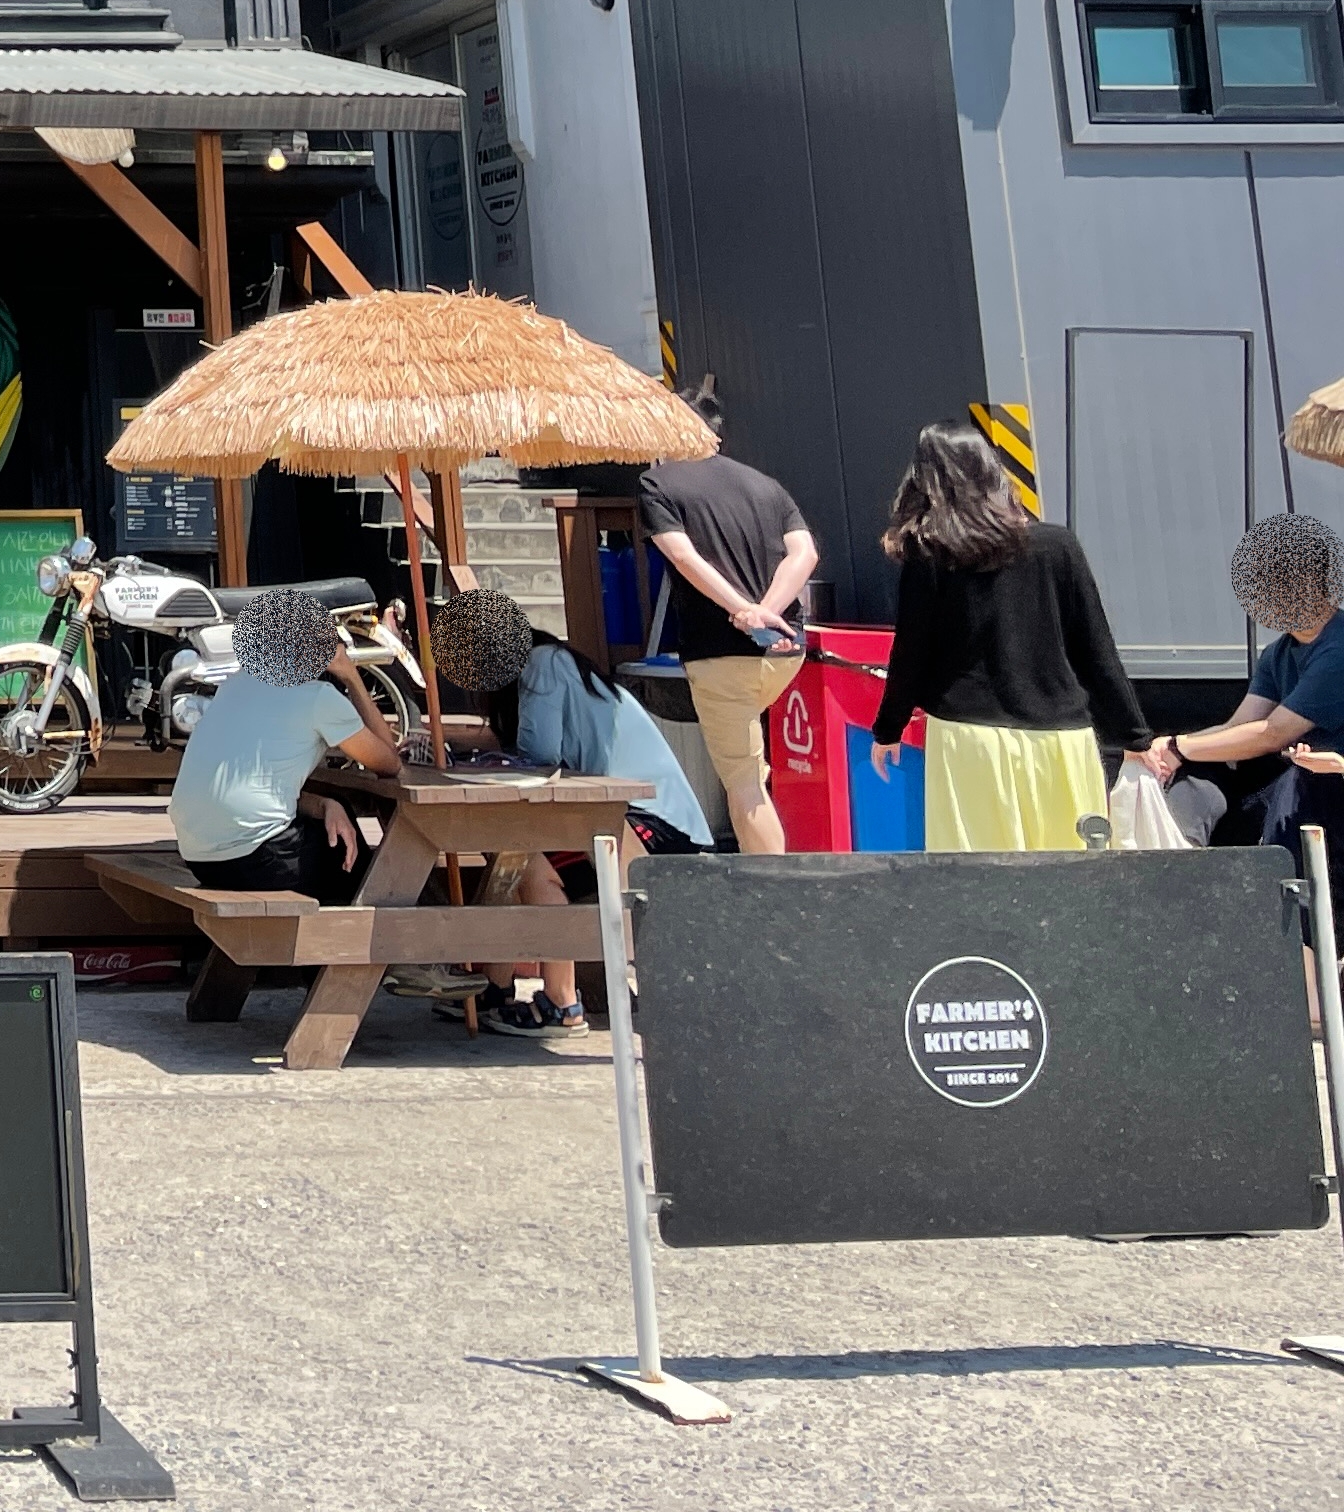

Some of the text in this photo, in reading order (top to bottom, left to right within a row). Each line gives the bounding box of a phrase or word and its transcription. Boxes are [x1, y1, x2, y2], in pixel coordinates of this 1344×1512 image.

[915, 999, 1034, 1024] FARMER'S
[924, 1029, 1030, 1053] KITCHEN
[946, 1072, 1019, 1086] SINCE 2014
